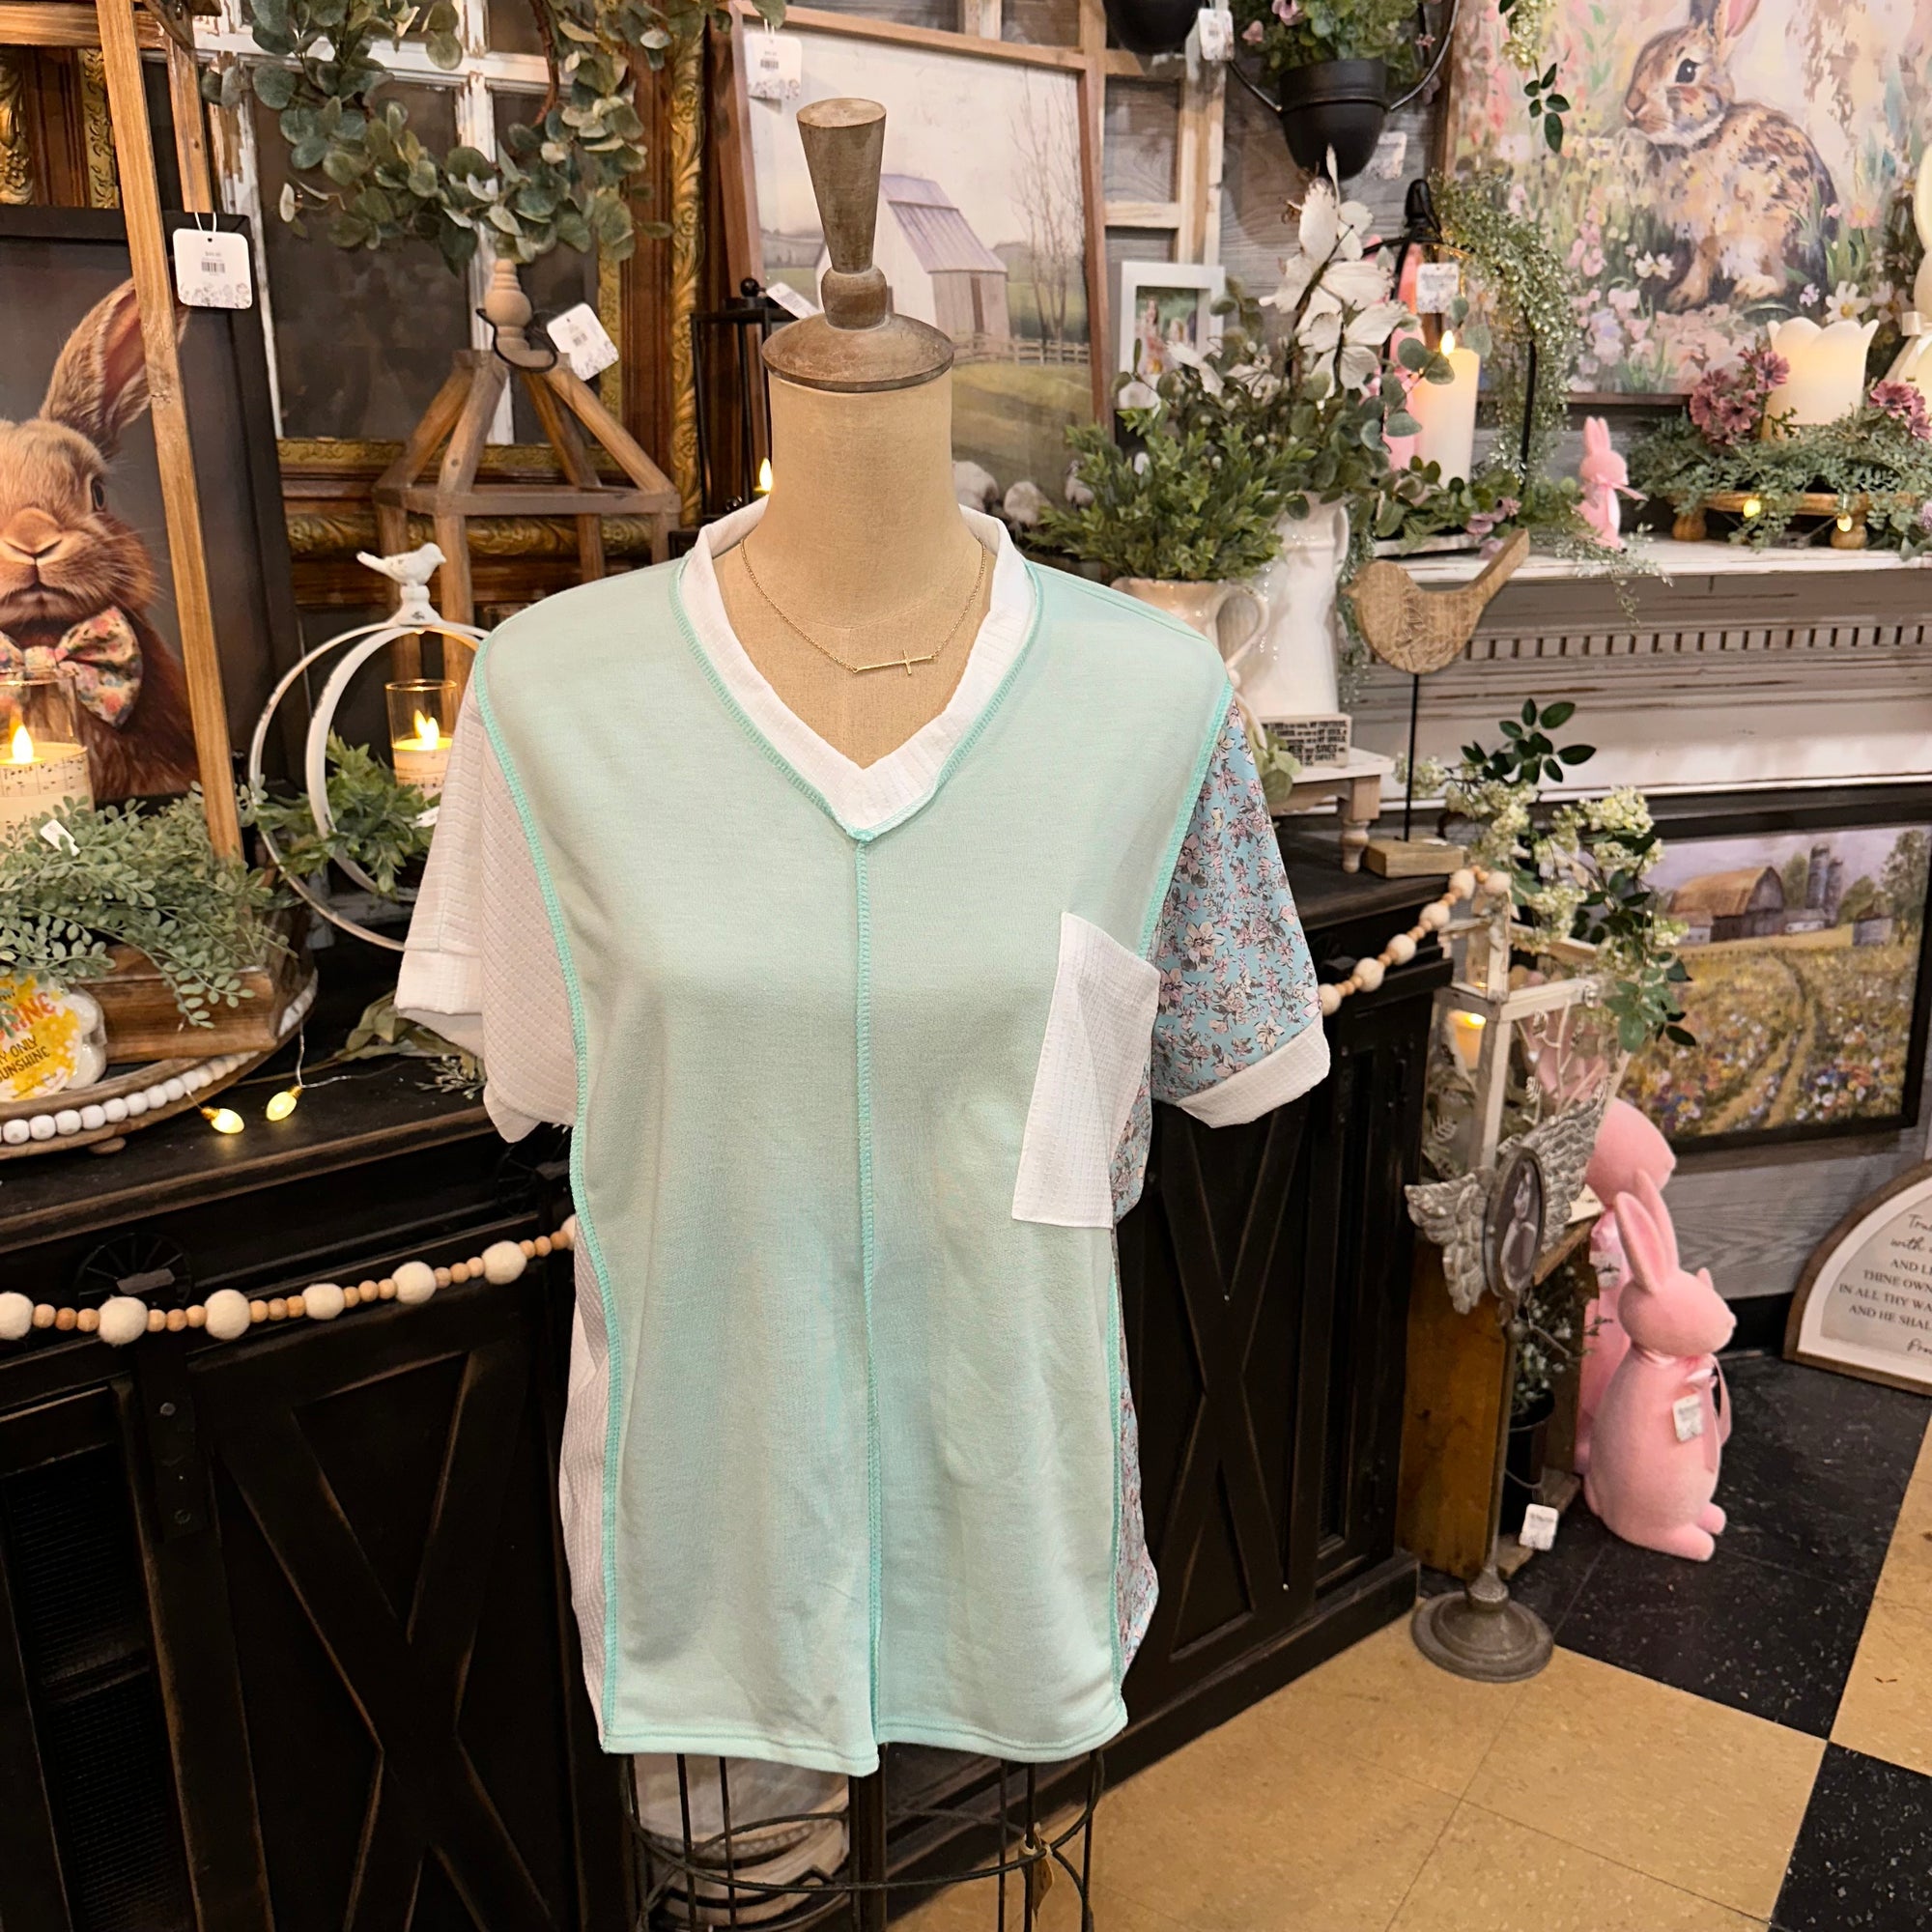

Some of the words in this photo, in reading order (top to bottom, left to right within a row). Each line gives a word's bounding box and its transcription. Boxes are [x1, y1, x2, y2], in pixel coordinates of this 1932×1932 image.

[10, 1035, 39, 1059] ONLY
[0, 1046, 49, 1083] UNSHINE
[1890, 1259, 1918, 1271] AND
[1863, 1269, 1899, 1285] THINE
[1838, 1283, 1853, 1294] IN
[1855, 1288, 1879, 1300] ALL
[1884, 1293, 1909, 1306] THY
[1849, 1304, 1876, 1318] AND
[1878, 1311, 1894, 1321] HE
